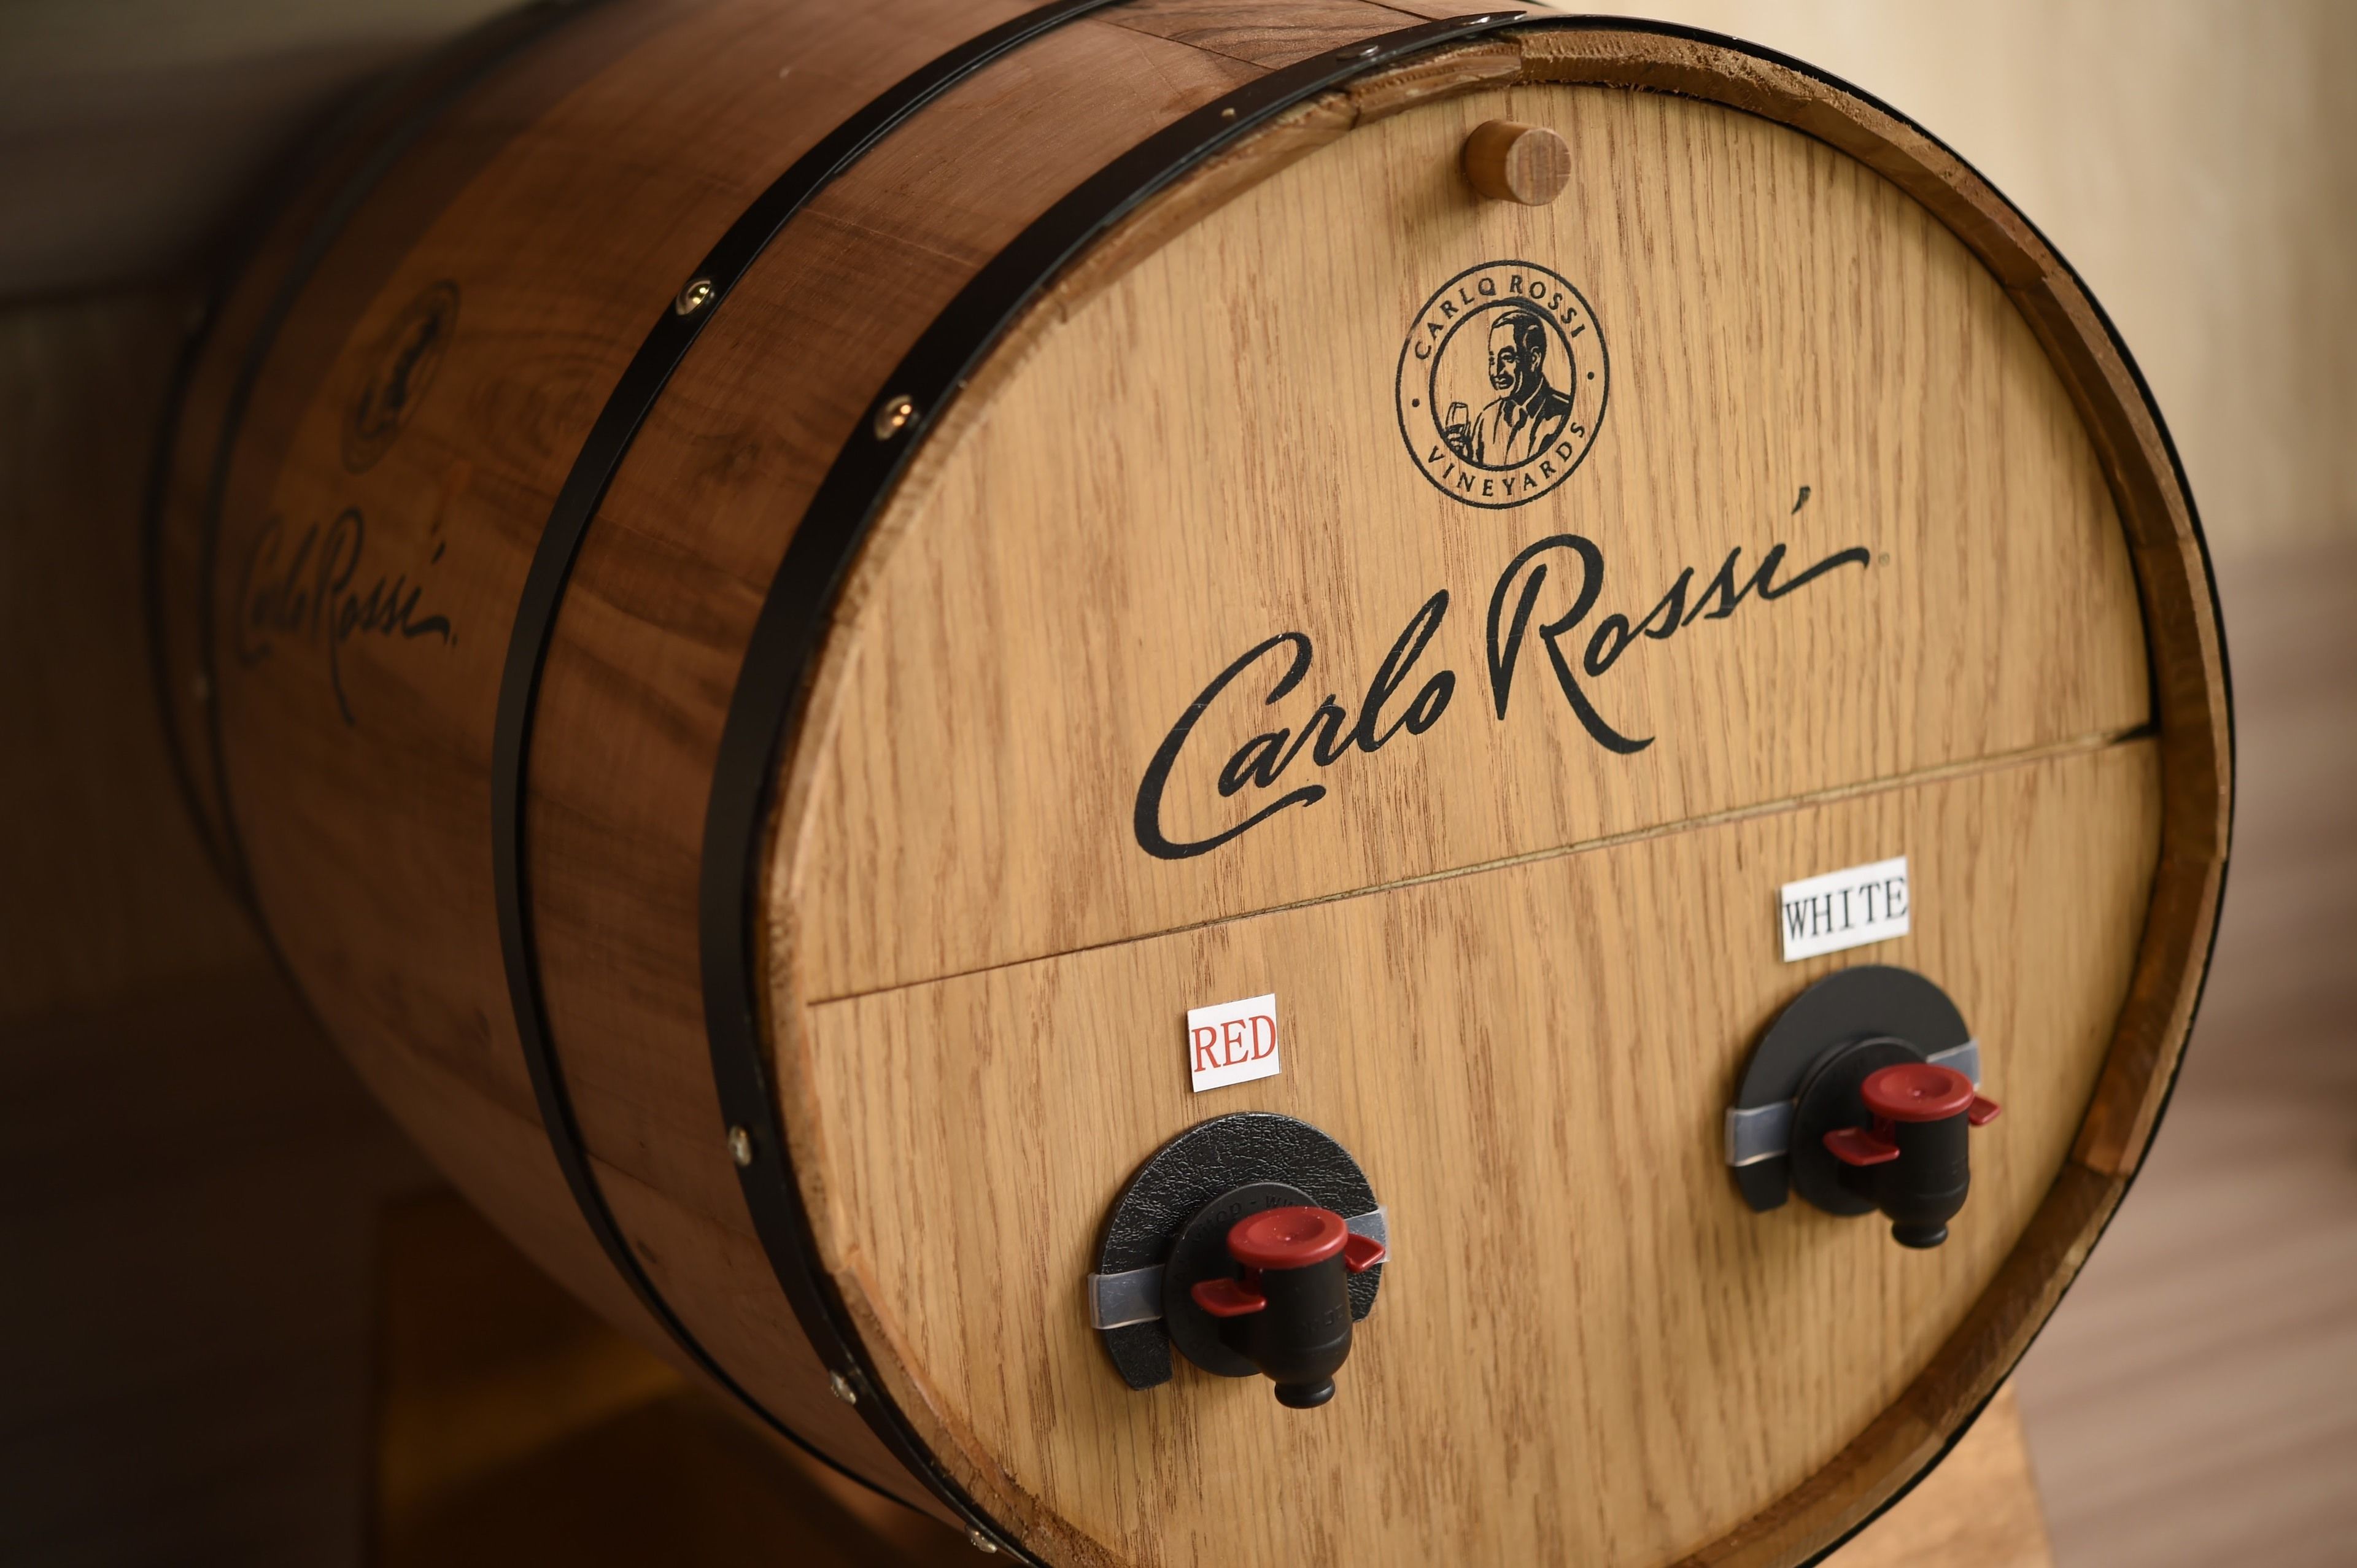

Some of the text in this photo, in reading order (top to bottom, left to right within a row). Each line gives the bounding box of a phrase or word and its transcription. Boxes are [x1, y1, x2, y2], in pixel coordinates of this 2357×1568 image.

[1415, 274, 1585, 360] CARLO ROSSI
[1428, 422, 1585, 496] VINEYARDS
[1134, 485, 1870, 860] Carlo Rossi
[1783, 877, 1908, 941] WHITE
[1191, 1014, 1276, 1072] RED
